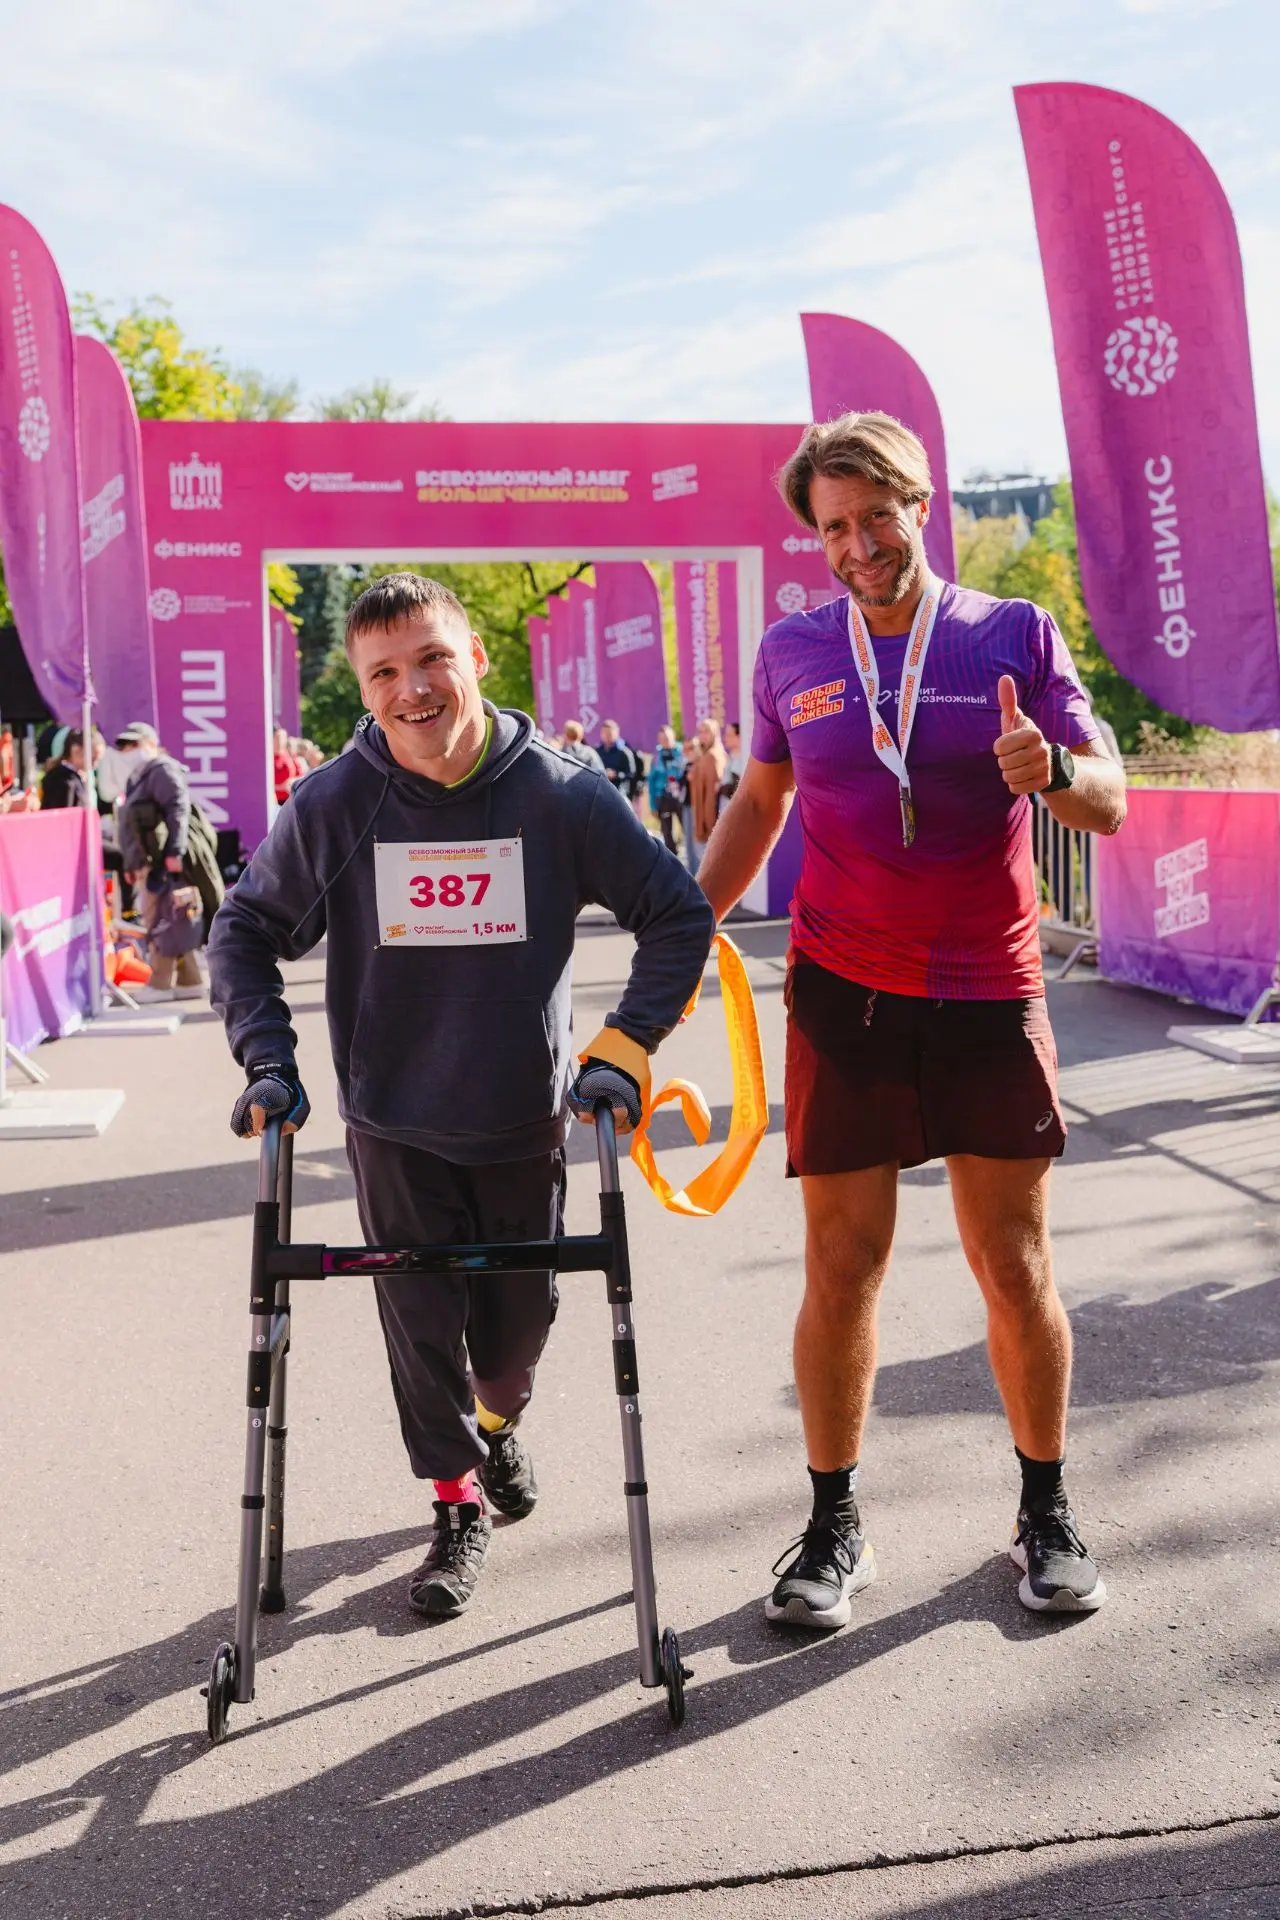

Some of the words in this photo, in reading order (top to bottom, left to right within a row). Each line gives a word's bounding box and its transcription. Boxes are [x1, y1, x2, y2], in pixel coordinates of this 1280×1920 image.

[170, 495, 223, 510] ВДНХ
[154, 538, 242, 560] ФЕНИКС
[782, 534, 824, 555] ФЕН
[1144, 454, 1197, 658] ФЕНИКС
[793, 681, 843, 707] БОЛЬШЕ
[803, 695, 827, 711] ЧЕМ
[792, 702, 841, 726] МОЖЕШЬ
[181, 650, 229, 824] ИНИШ
[409, 873, 492, 908] 387
[472, 923, 493, 936] 1,5
